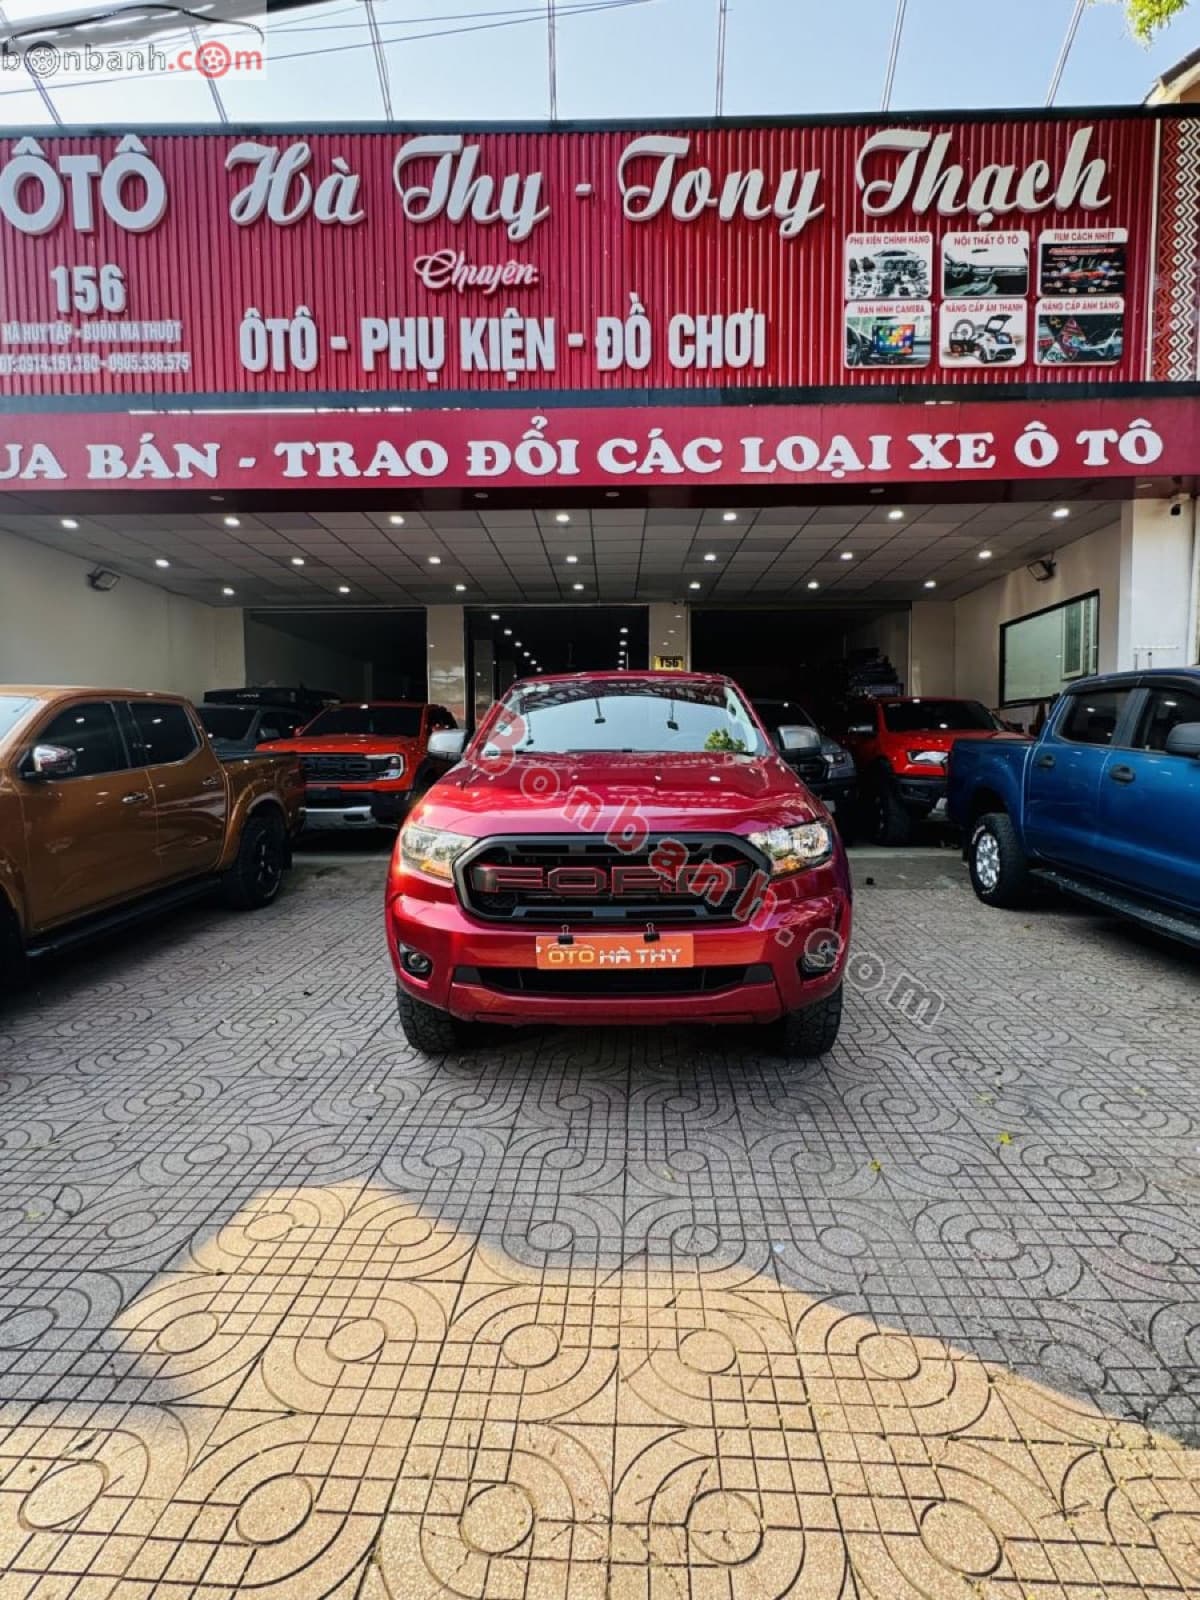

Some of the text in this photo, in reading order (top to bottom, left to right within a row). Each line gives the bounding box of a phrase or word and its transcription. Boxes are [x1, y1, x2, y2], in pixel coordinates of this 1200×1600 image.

[0, 134, 167, 235] ÔTÔ
[224, 141, 364, 226] Hà
[393, 135, 549, 241] Thy
[617, 134, 825, 238] Tony
[854, 126, 1111, 227] Thạch
[50, 263, 126, 314] 156
[239, 305, 318, 373] ÔTÔ
[361, 316, 445, 382] PHỤ
[460, 308, 556, 381] KIỆN
[595, 292, 652, 371] ĐỒ
[667, 307, 766, 369] CHƠI
[86, 432, 221, 479] BÁN
[274, 440, 448, 478] TRAO
[467, 416, 580, 476] ĐỔI
[600, 428, 722, 475] CÁC
[740, 434, 892, 478] LOẠI
[908, 432, 995, 470] XE
[1014, 420, 1059, 468] Ô
[1076, 418, 1163, 466] TÔ
[635, 949, 681, 963] THY
